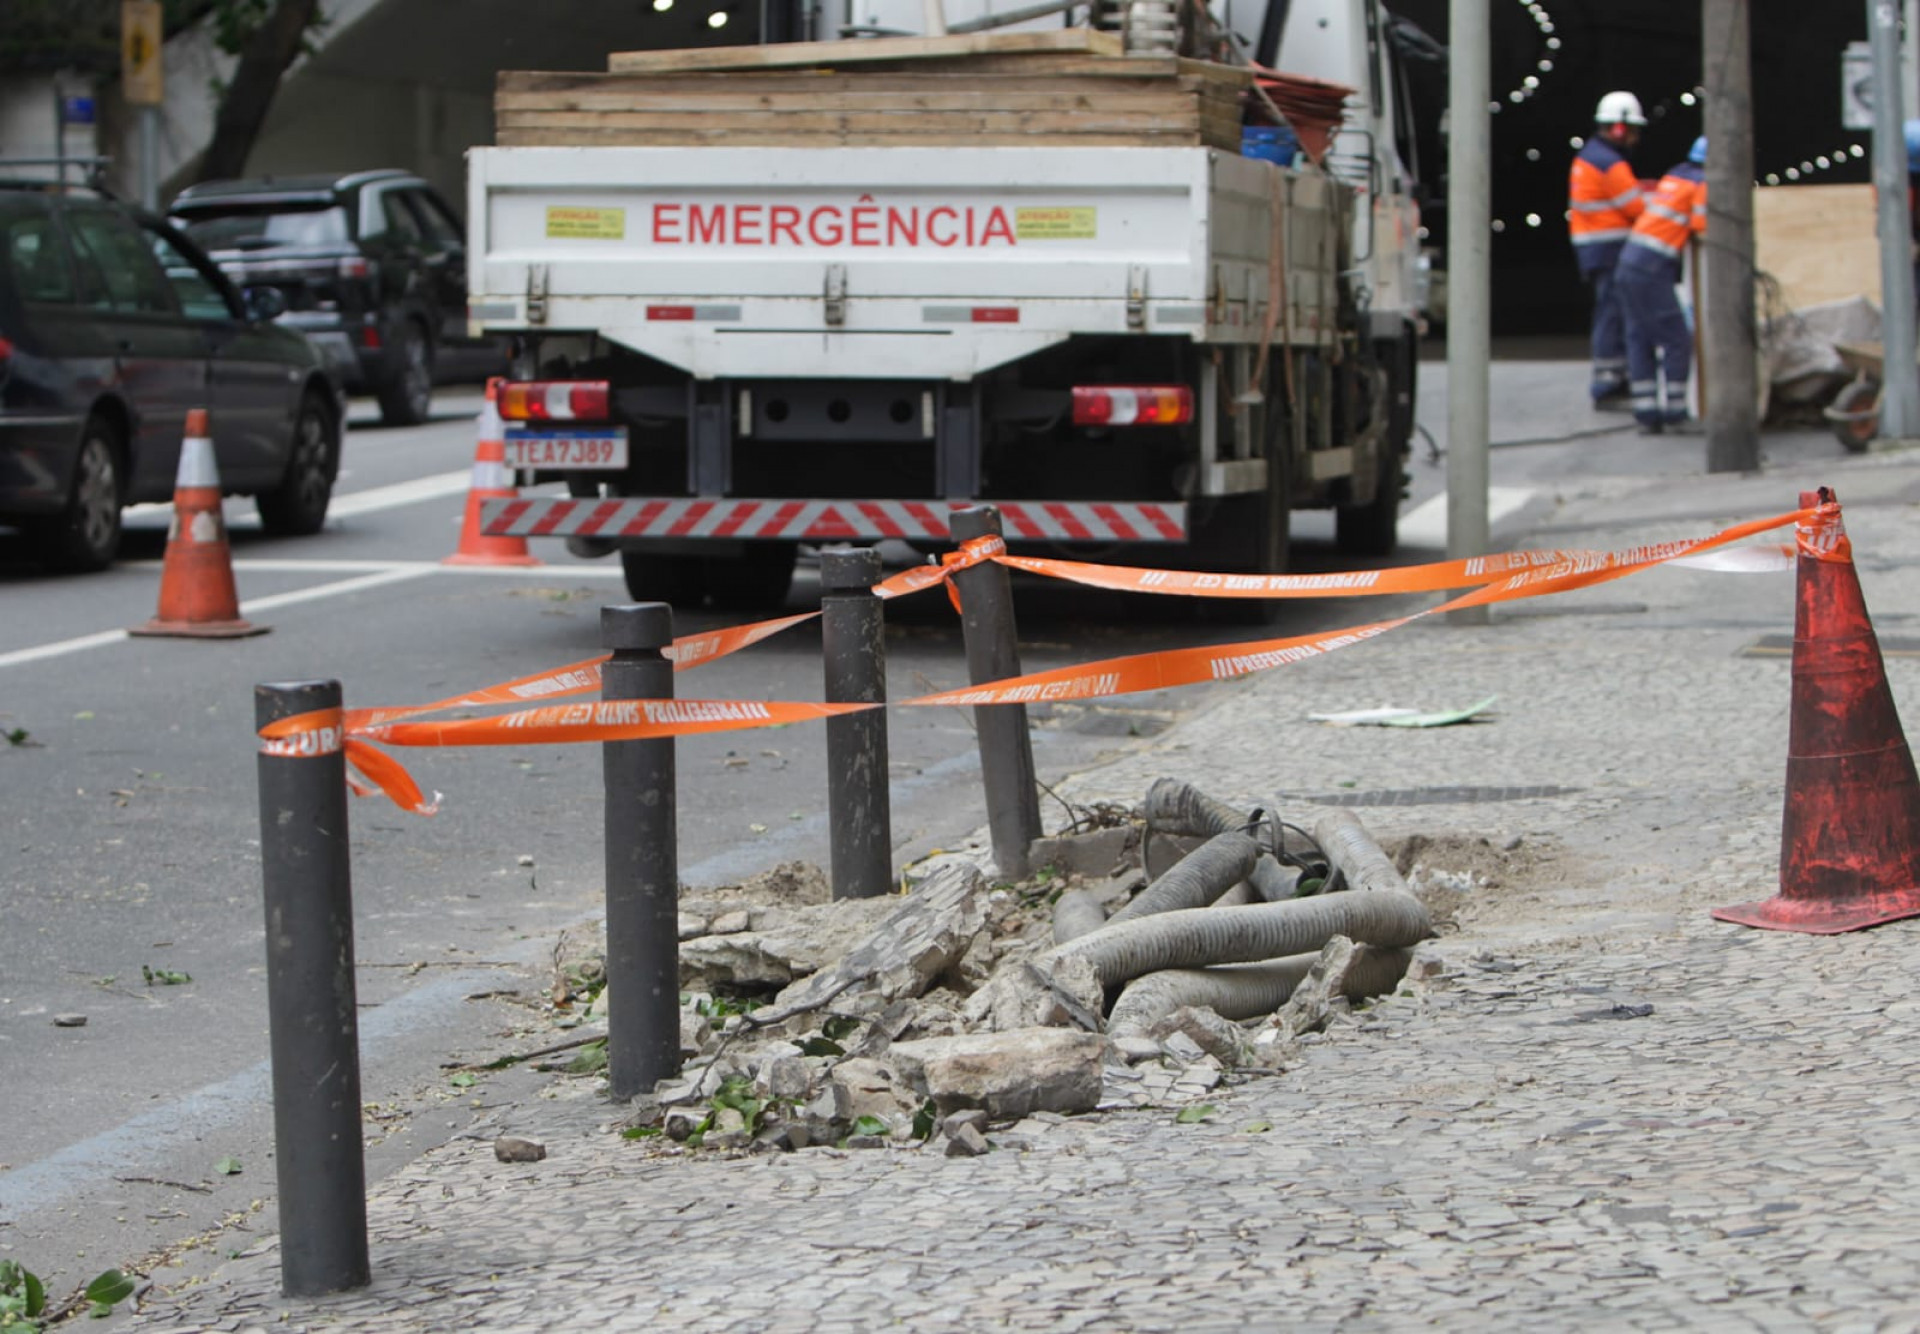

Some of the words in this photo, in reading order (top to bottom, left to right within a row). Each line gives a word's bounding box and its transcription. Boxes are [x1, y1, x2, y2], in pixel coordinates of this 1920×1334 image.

[652, 194, 1016, 247] EMERGÊNCIA
[515, 440, 614, 463] TEA7J89
[1231, 644, 1323, 673] PREFEITURA
[596, 702, 641, 725] SMTR
[642, 701, 743, 724] PREFEITURA
